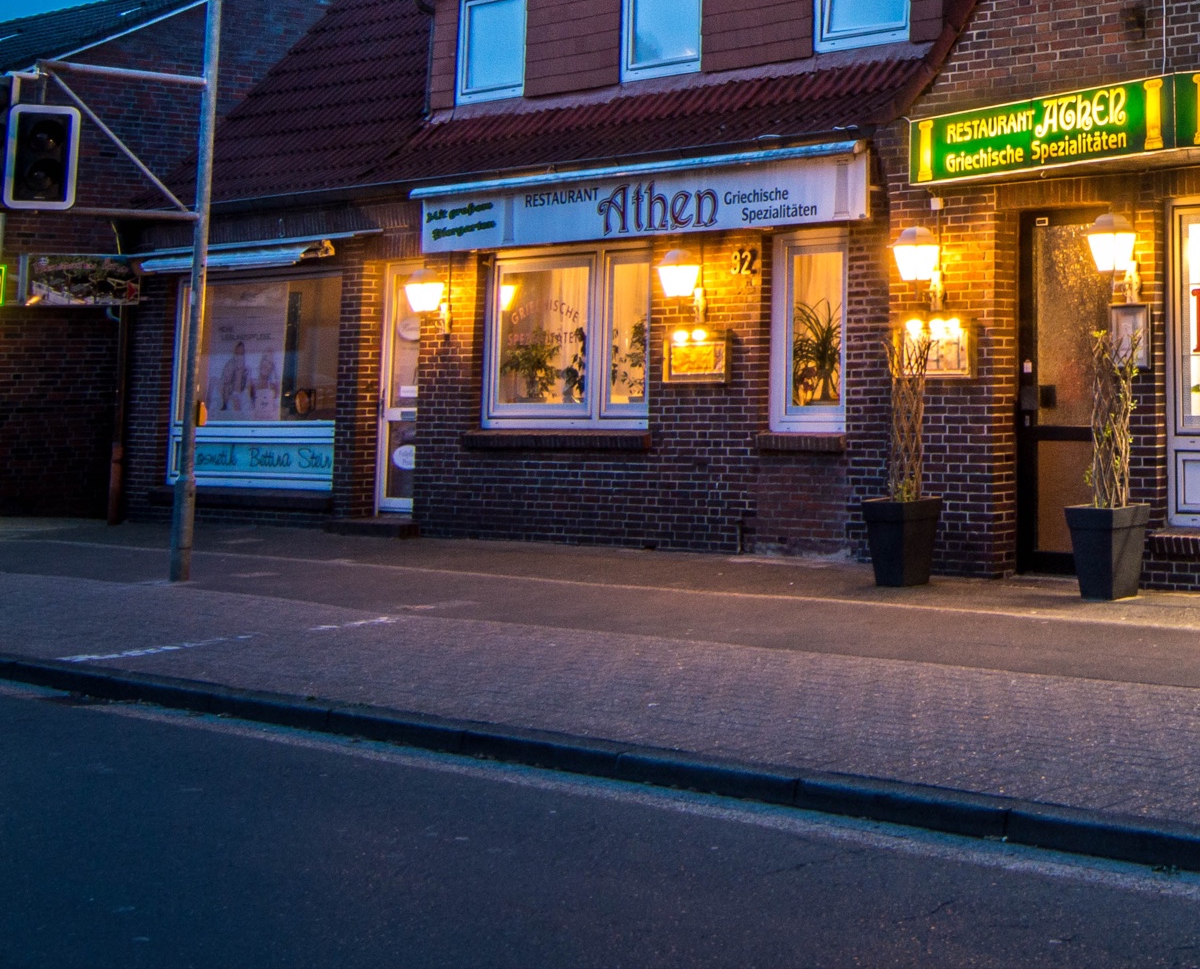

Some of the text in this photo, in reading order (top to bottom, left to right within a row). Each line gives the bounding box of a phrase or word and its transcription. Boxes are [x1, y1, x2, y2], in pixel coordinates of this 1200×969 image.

[946, 109, 1036, 144] RESTAURANT
[945, 131, 1127, 173] Griechische Spezialitäten
[525, 180, 789, 236] RESTAURANT Athen Griechische
[741, 204, 818, 224] Spezialitäten
[730, 251, 752, 275] 92
[511, 299, 580, 325] GRIEISCHE
[507, 331, 582, 347] SPELITÄTE
[195, 444, 332, 469] osmetik Bettina Stein
